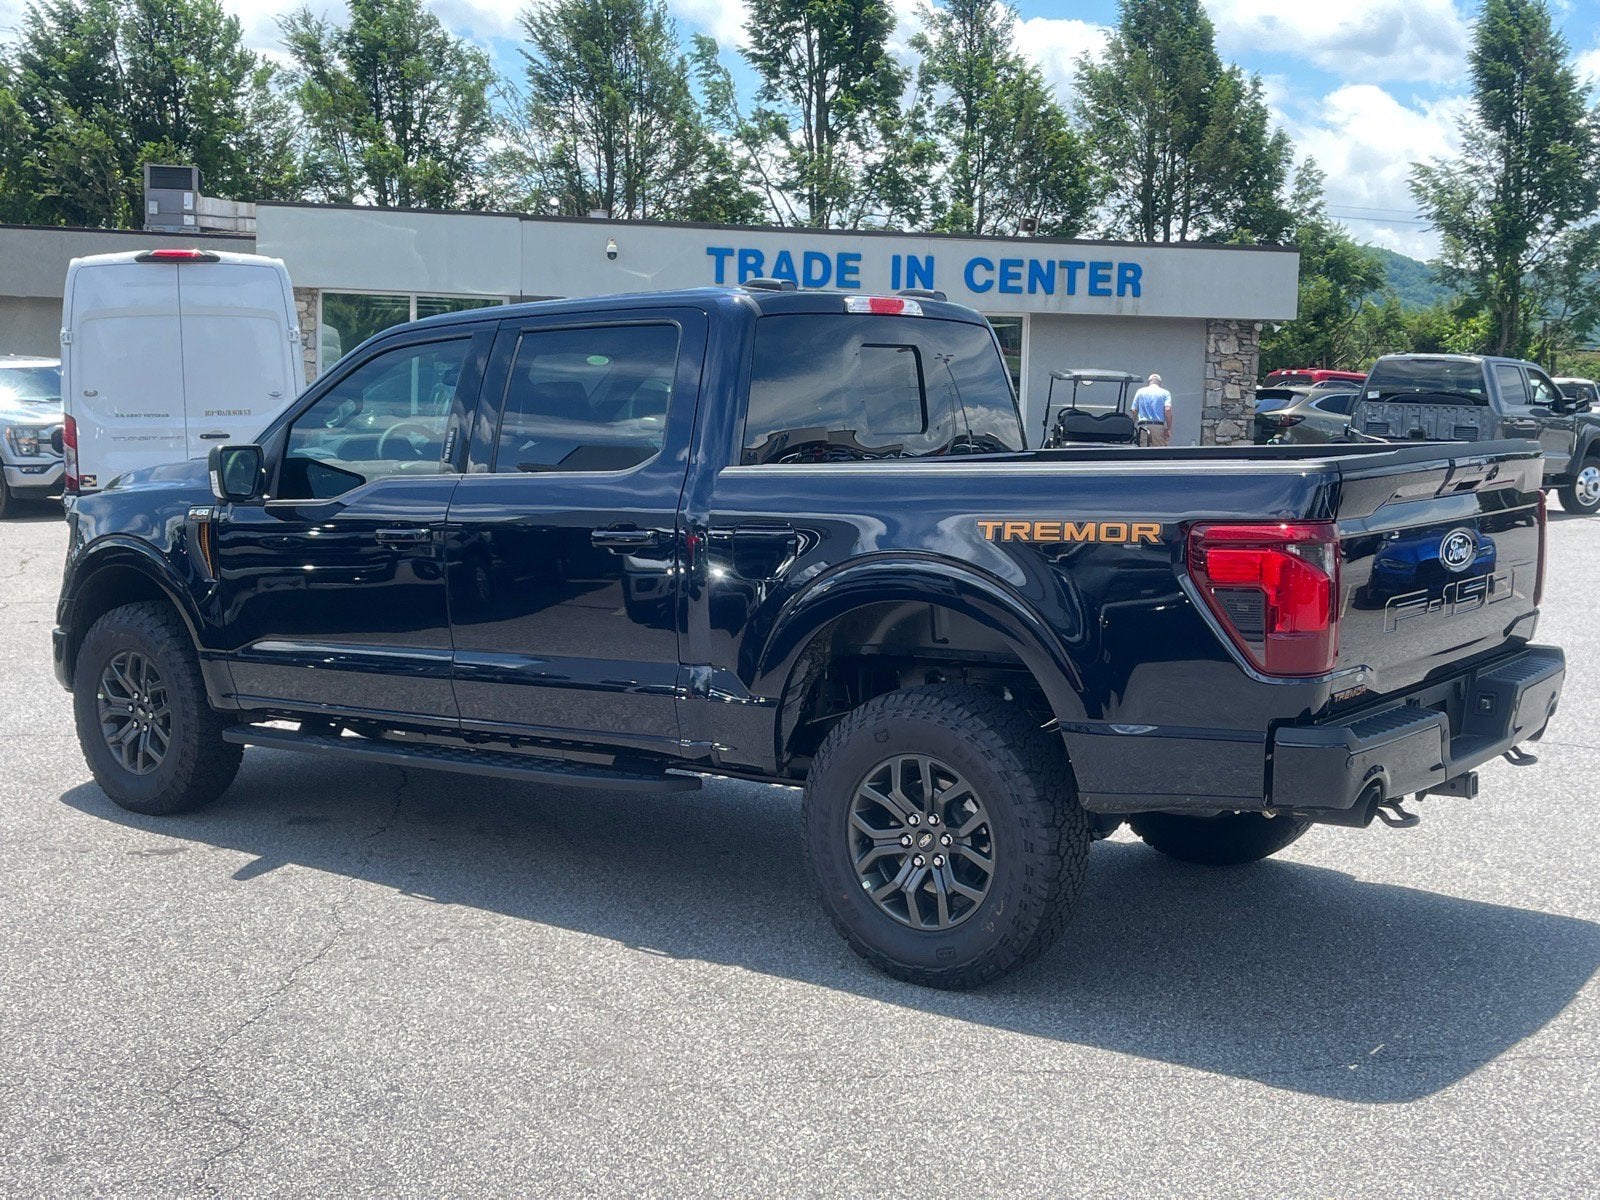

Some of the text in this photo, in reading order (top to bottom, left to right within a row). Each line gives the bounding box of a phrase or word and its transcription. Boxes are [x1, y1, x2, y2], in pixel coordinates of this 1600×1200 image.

[706, 246, 1143, 297] TRADE IN CENTER
[976, 519, 1163, 545] TREMOR
[1448, 536, 1469, 562] Ford
[1383, 568, 1515, 634] F-150
[1334, 685, 1367, 703] TREMOR
